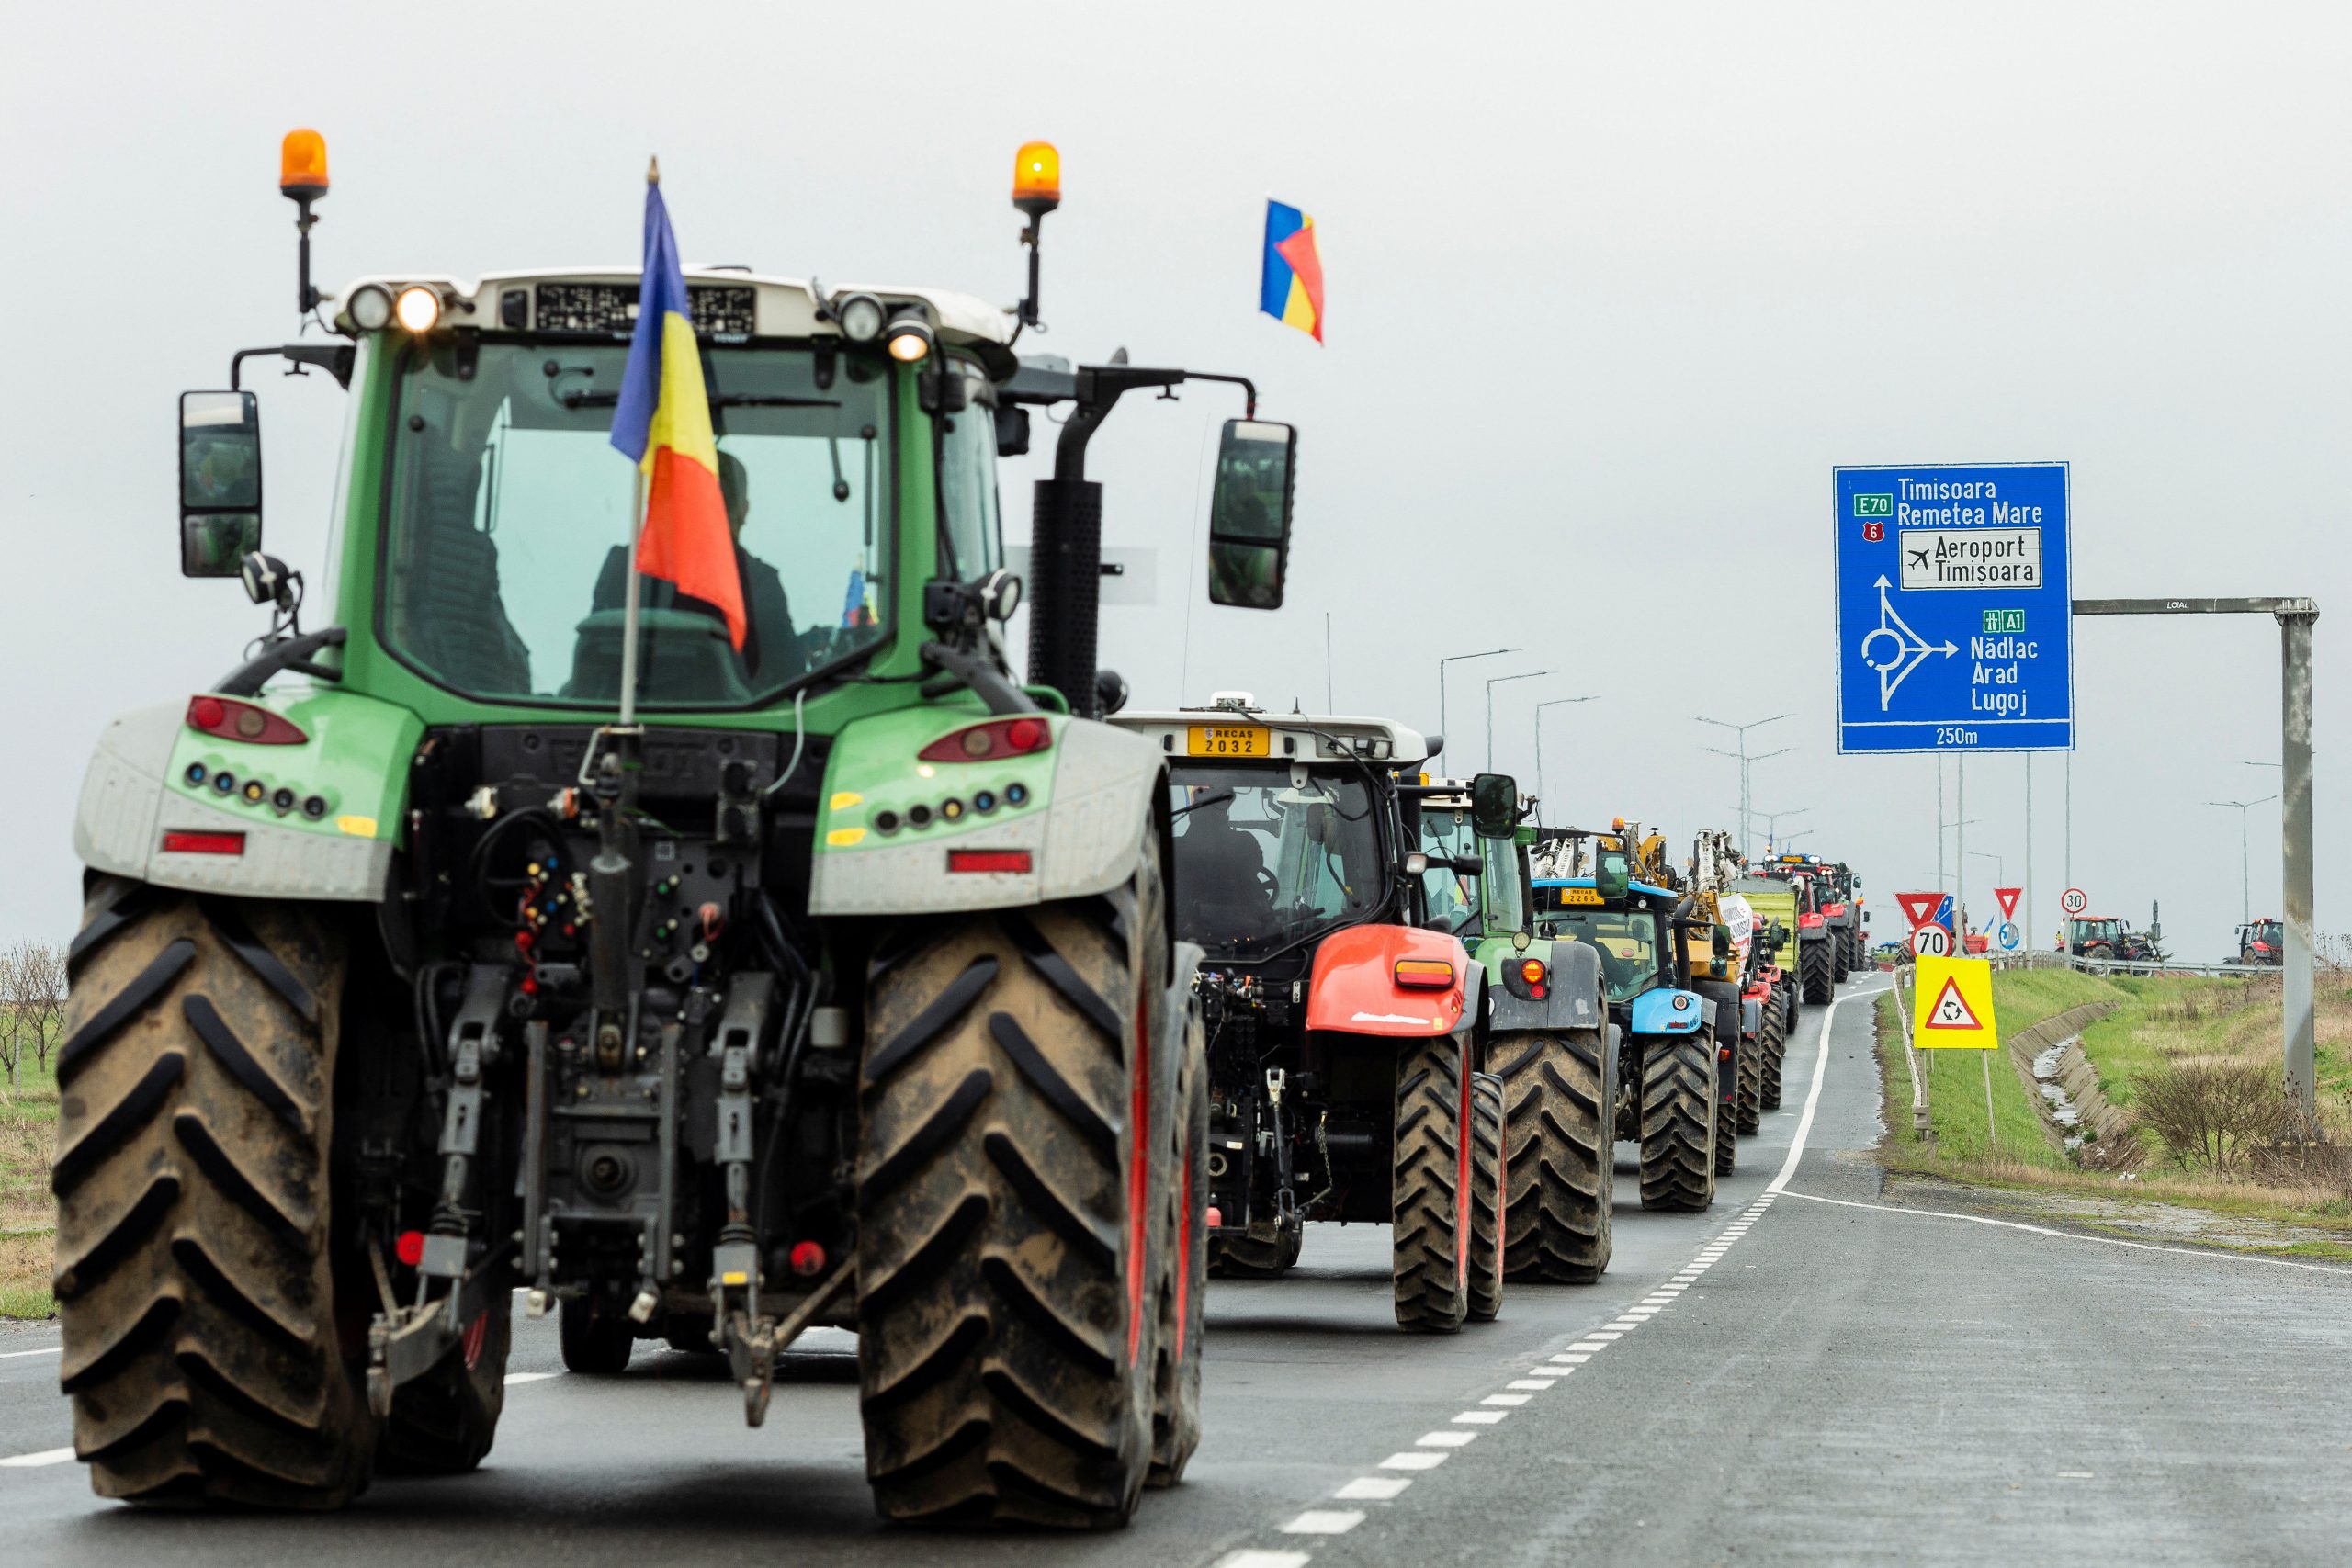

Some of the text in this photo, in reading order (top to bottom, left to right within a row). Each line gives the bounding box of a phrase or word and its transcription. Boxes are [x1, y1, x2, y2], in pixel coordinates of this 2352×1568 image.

[1898, 477, 1996, 503] Timișoara
[1860, 497, 1888, 513] E70
[1898, 501, 2042, 525] Remetea Mare
[1869, 525, 1878, 539] 6
[1935, 535, 2025, 562] Aeroport
[1935, 559, 2034, 585] Timișoara
[2006, 614, 2021, 629] A1
[1971, 637, 2038, 660] Nădlac
[1972, 661, 2018, 684] Arad
[1972, 688, 2027, 716] Lugoj
[1205, 740, 1253, 752] 2032
[1936, 727, 1978, 745] 250m
[2067, 895, 2082, 908] 30
[1919, 932, 1944, 954] 70
